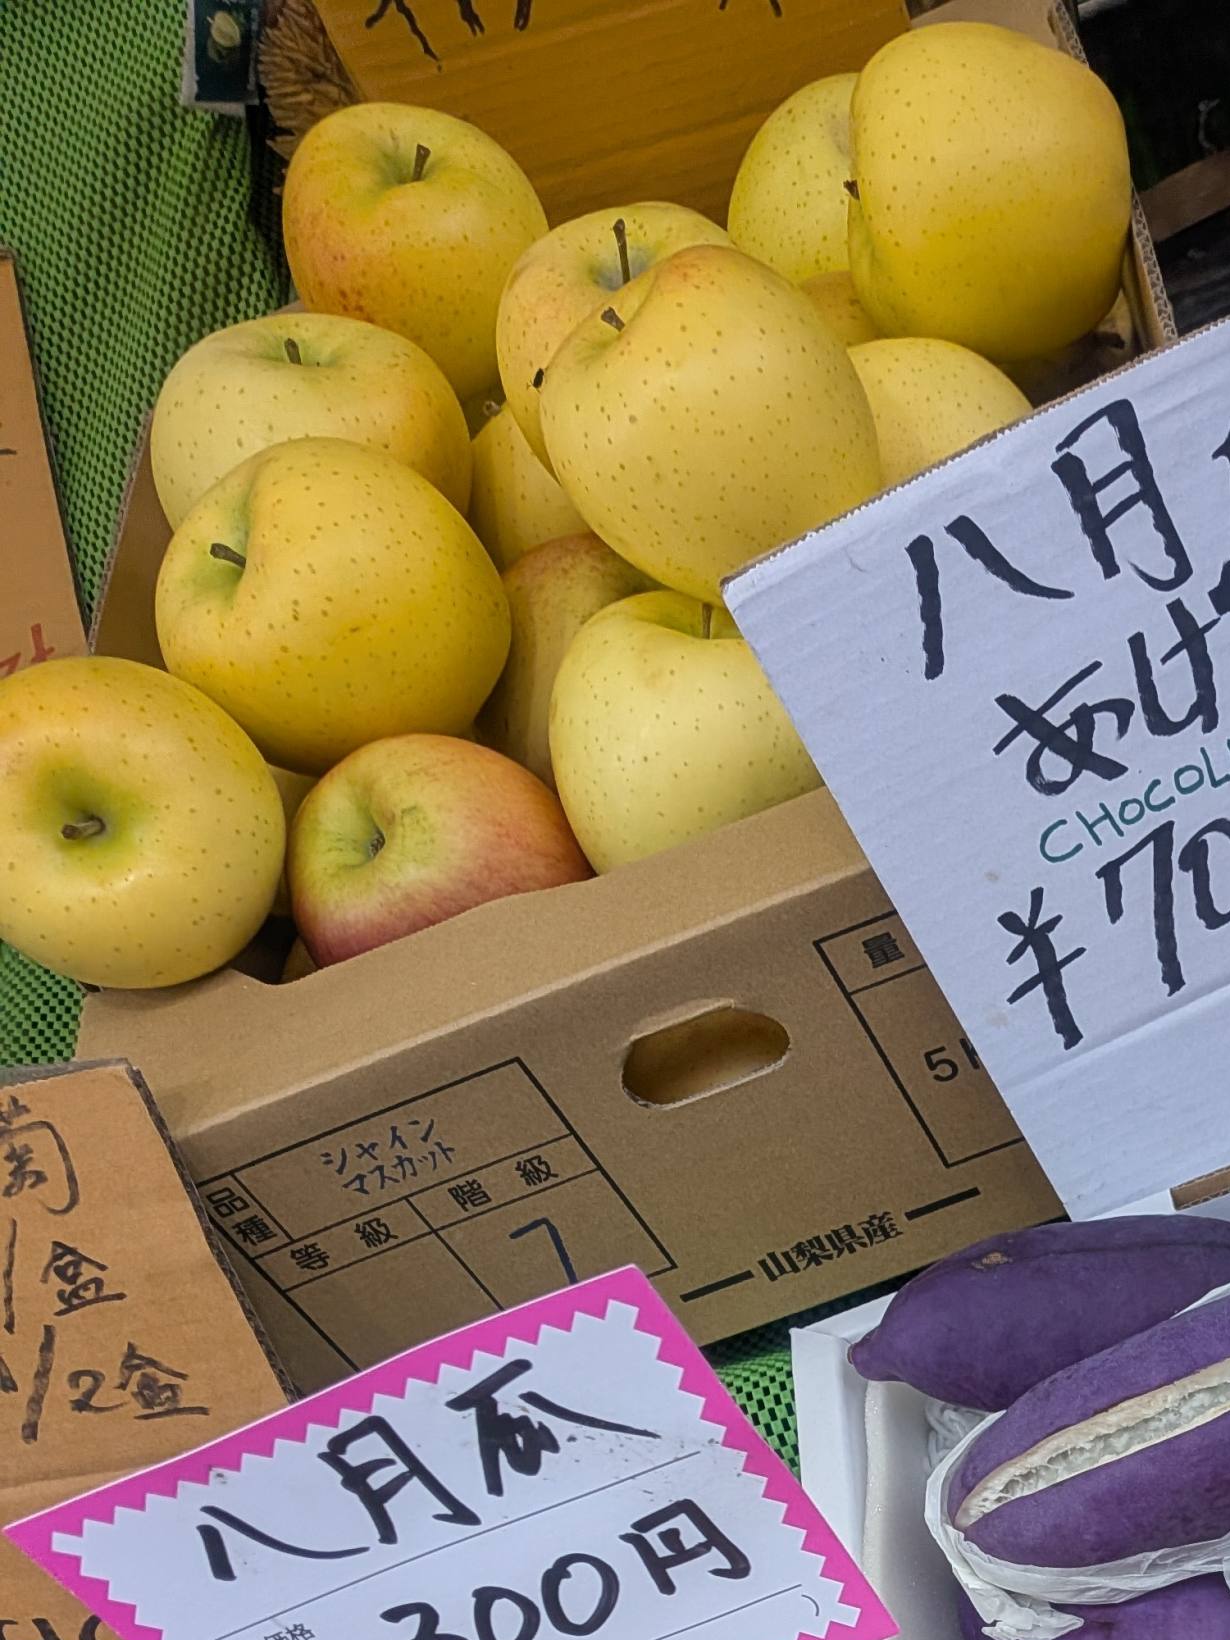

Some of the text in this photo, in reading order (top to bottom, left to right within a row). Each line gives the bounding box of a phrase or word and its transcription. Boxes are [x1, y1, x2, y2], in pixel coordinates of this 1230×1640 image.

[319, 1117, 436, 1176] シャイン
[341, 1140, 457, 1196] マスカット
[206, 1185, 279, 1247] 品種
[756, 1211, 904, 1283] 山梨県産
